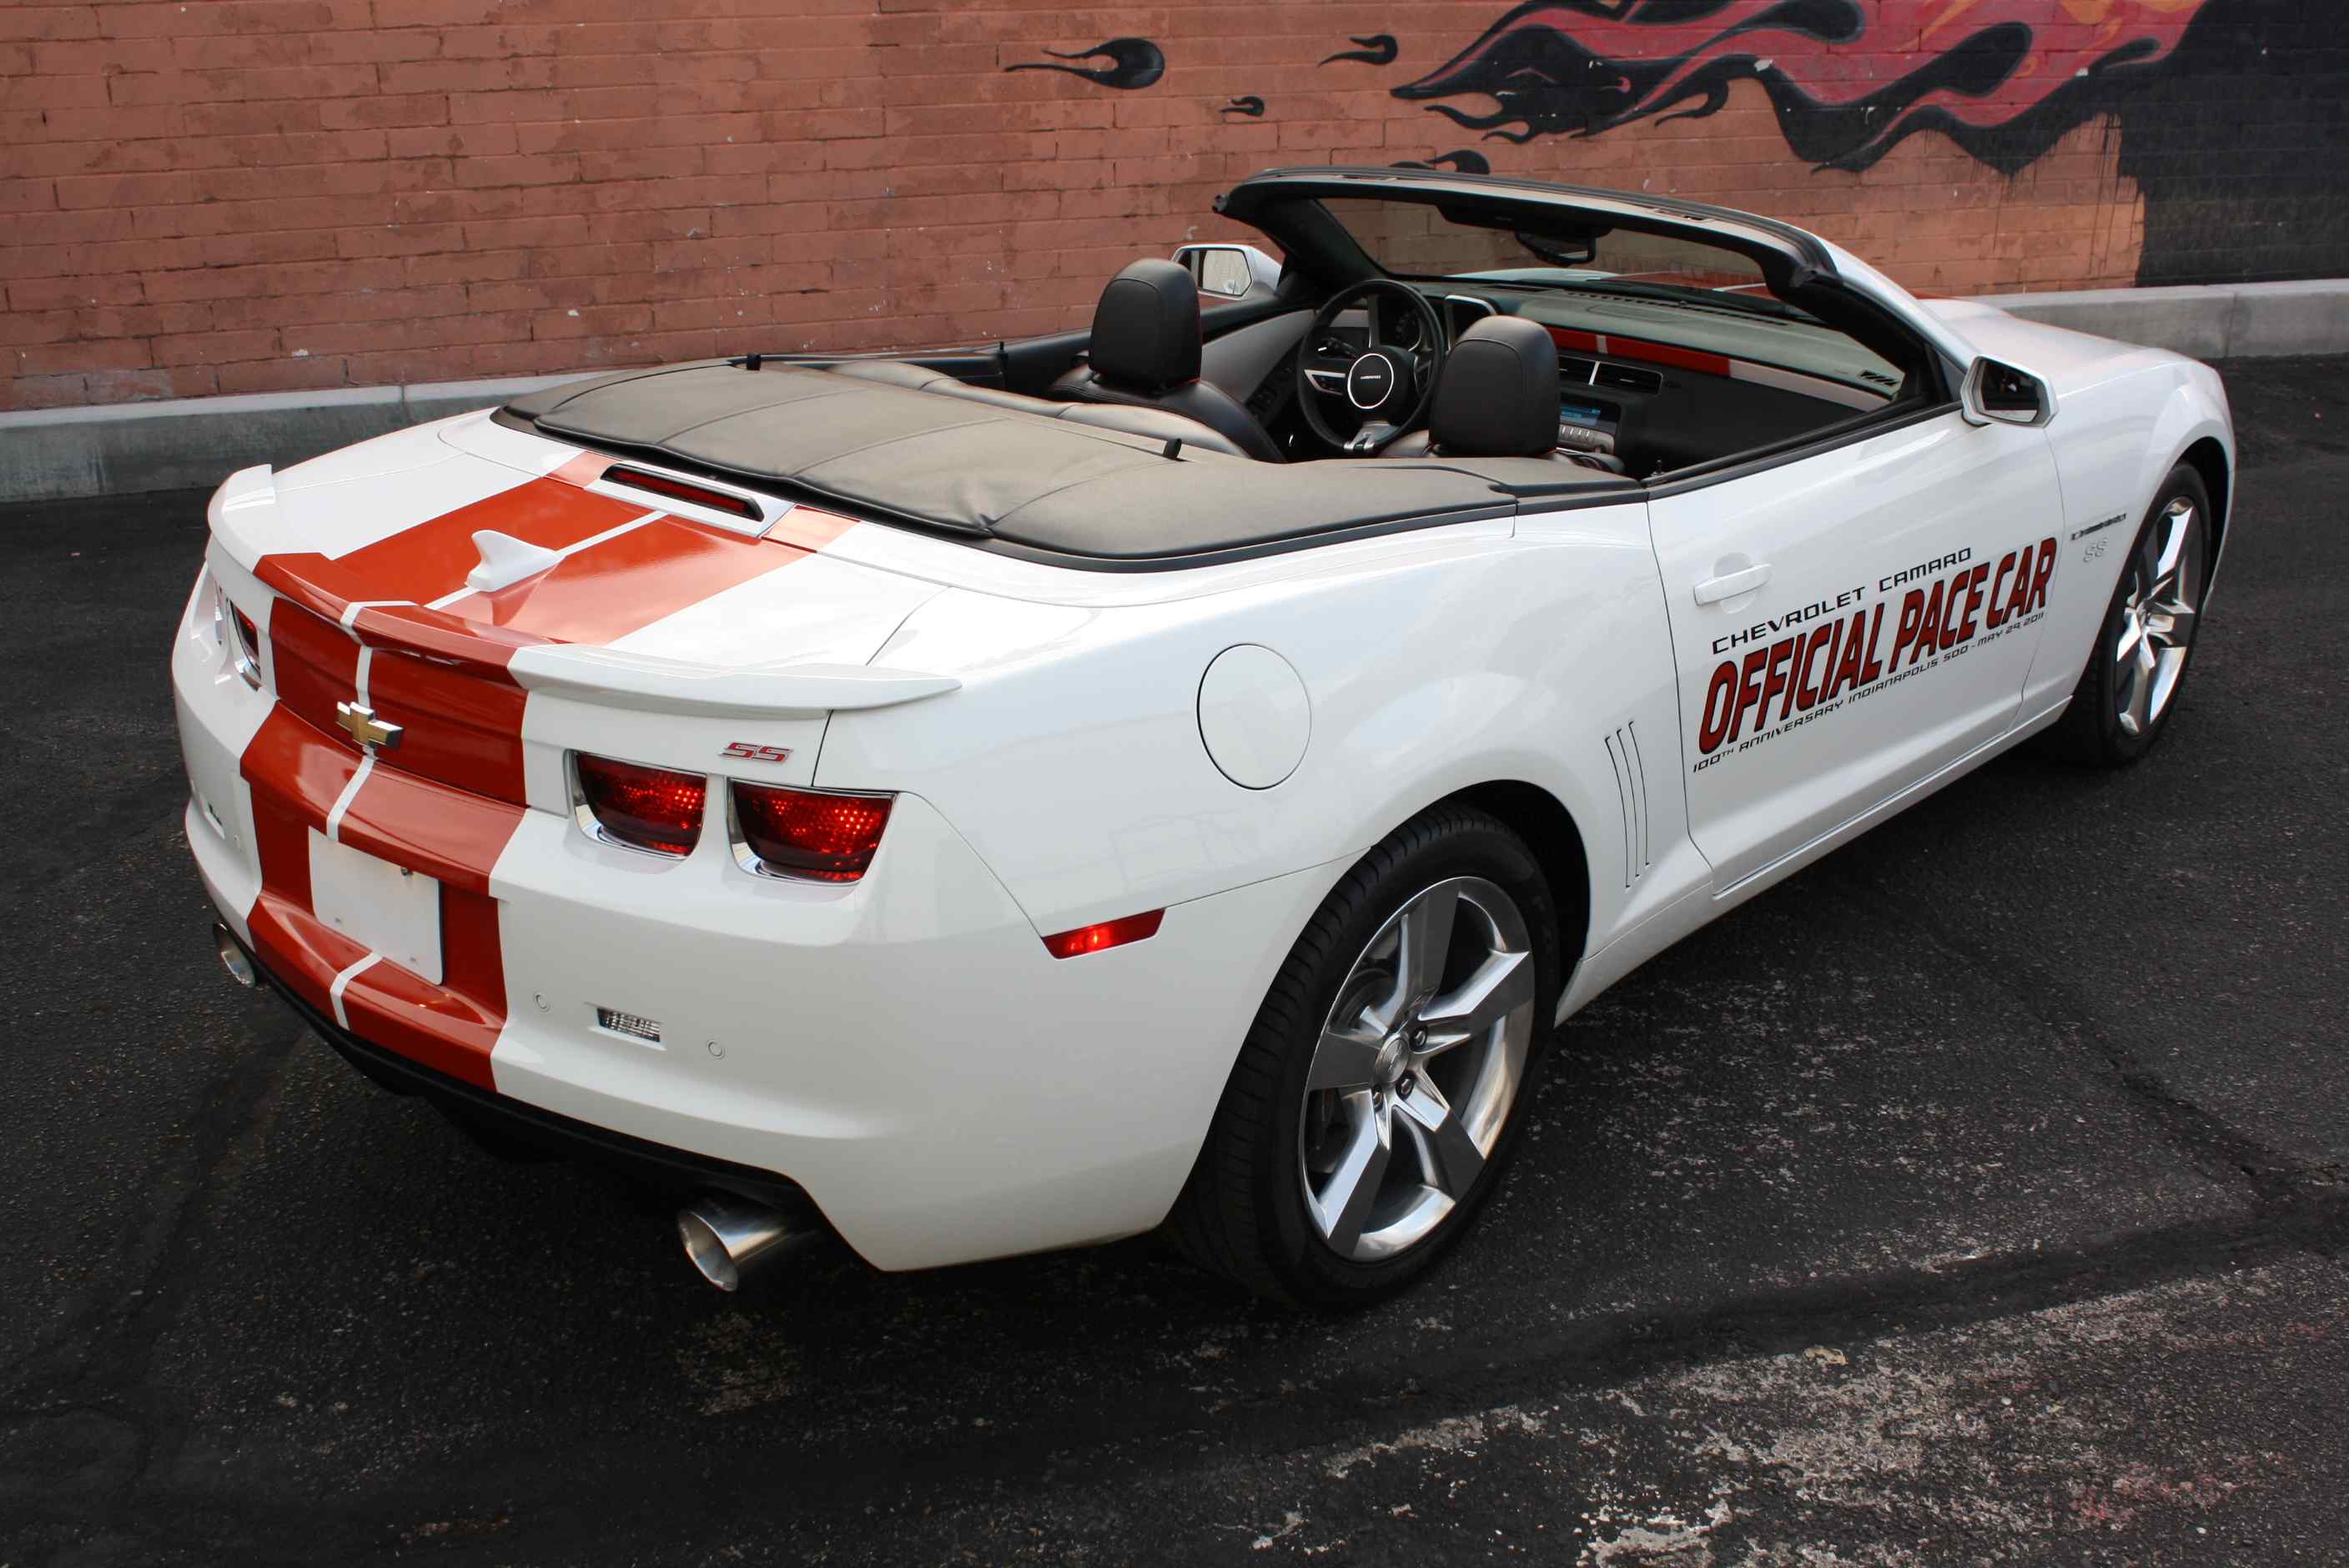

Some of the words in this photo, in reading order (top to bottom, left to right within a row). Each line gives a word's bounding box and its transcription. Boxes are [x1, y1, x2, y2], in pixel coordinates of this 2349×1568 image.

[1712, 586, 1866, 655] CHEVROLET
[1879, 547, 1971, 593] CAMARO
[2083, 536, 2109, 563] SS
[1698, 602, 1885, 755] OFFICIAL
[1888, 561, 1990, 675] PACE
[1986, 537, 2057, 630] CAR
[1738, 699, 1843, 752] ANNIVERSARY
[1849, 658, 1939, 704] INDIANAPOLIS
[1943, 645, 1969, 662] 500
[1977, 630, 2003, 647] MAY
[2023, 611, 2044, 626] 2011
[718, 741, 794, 763] SS
